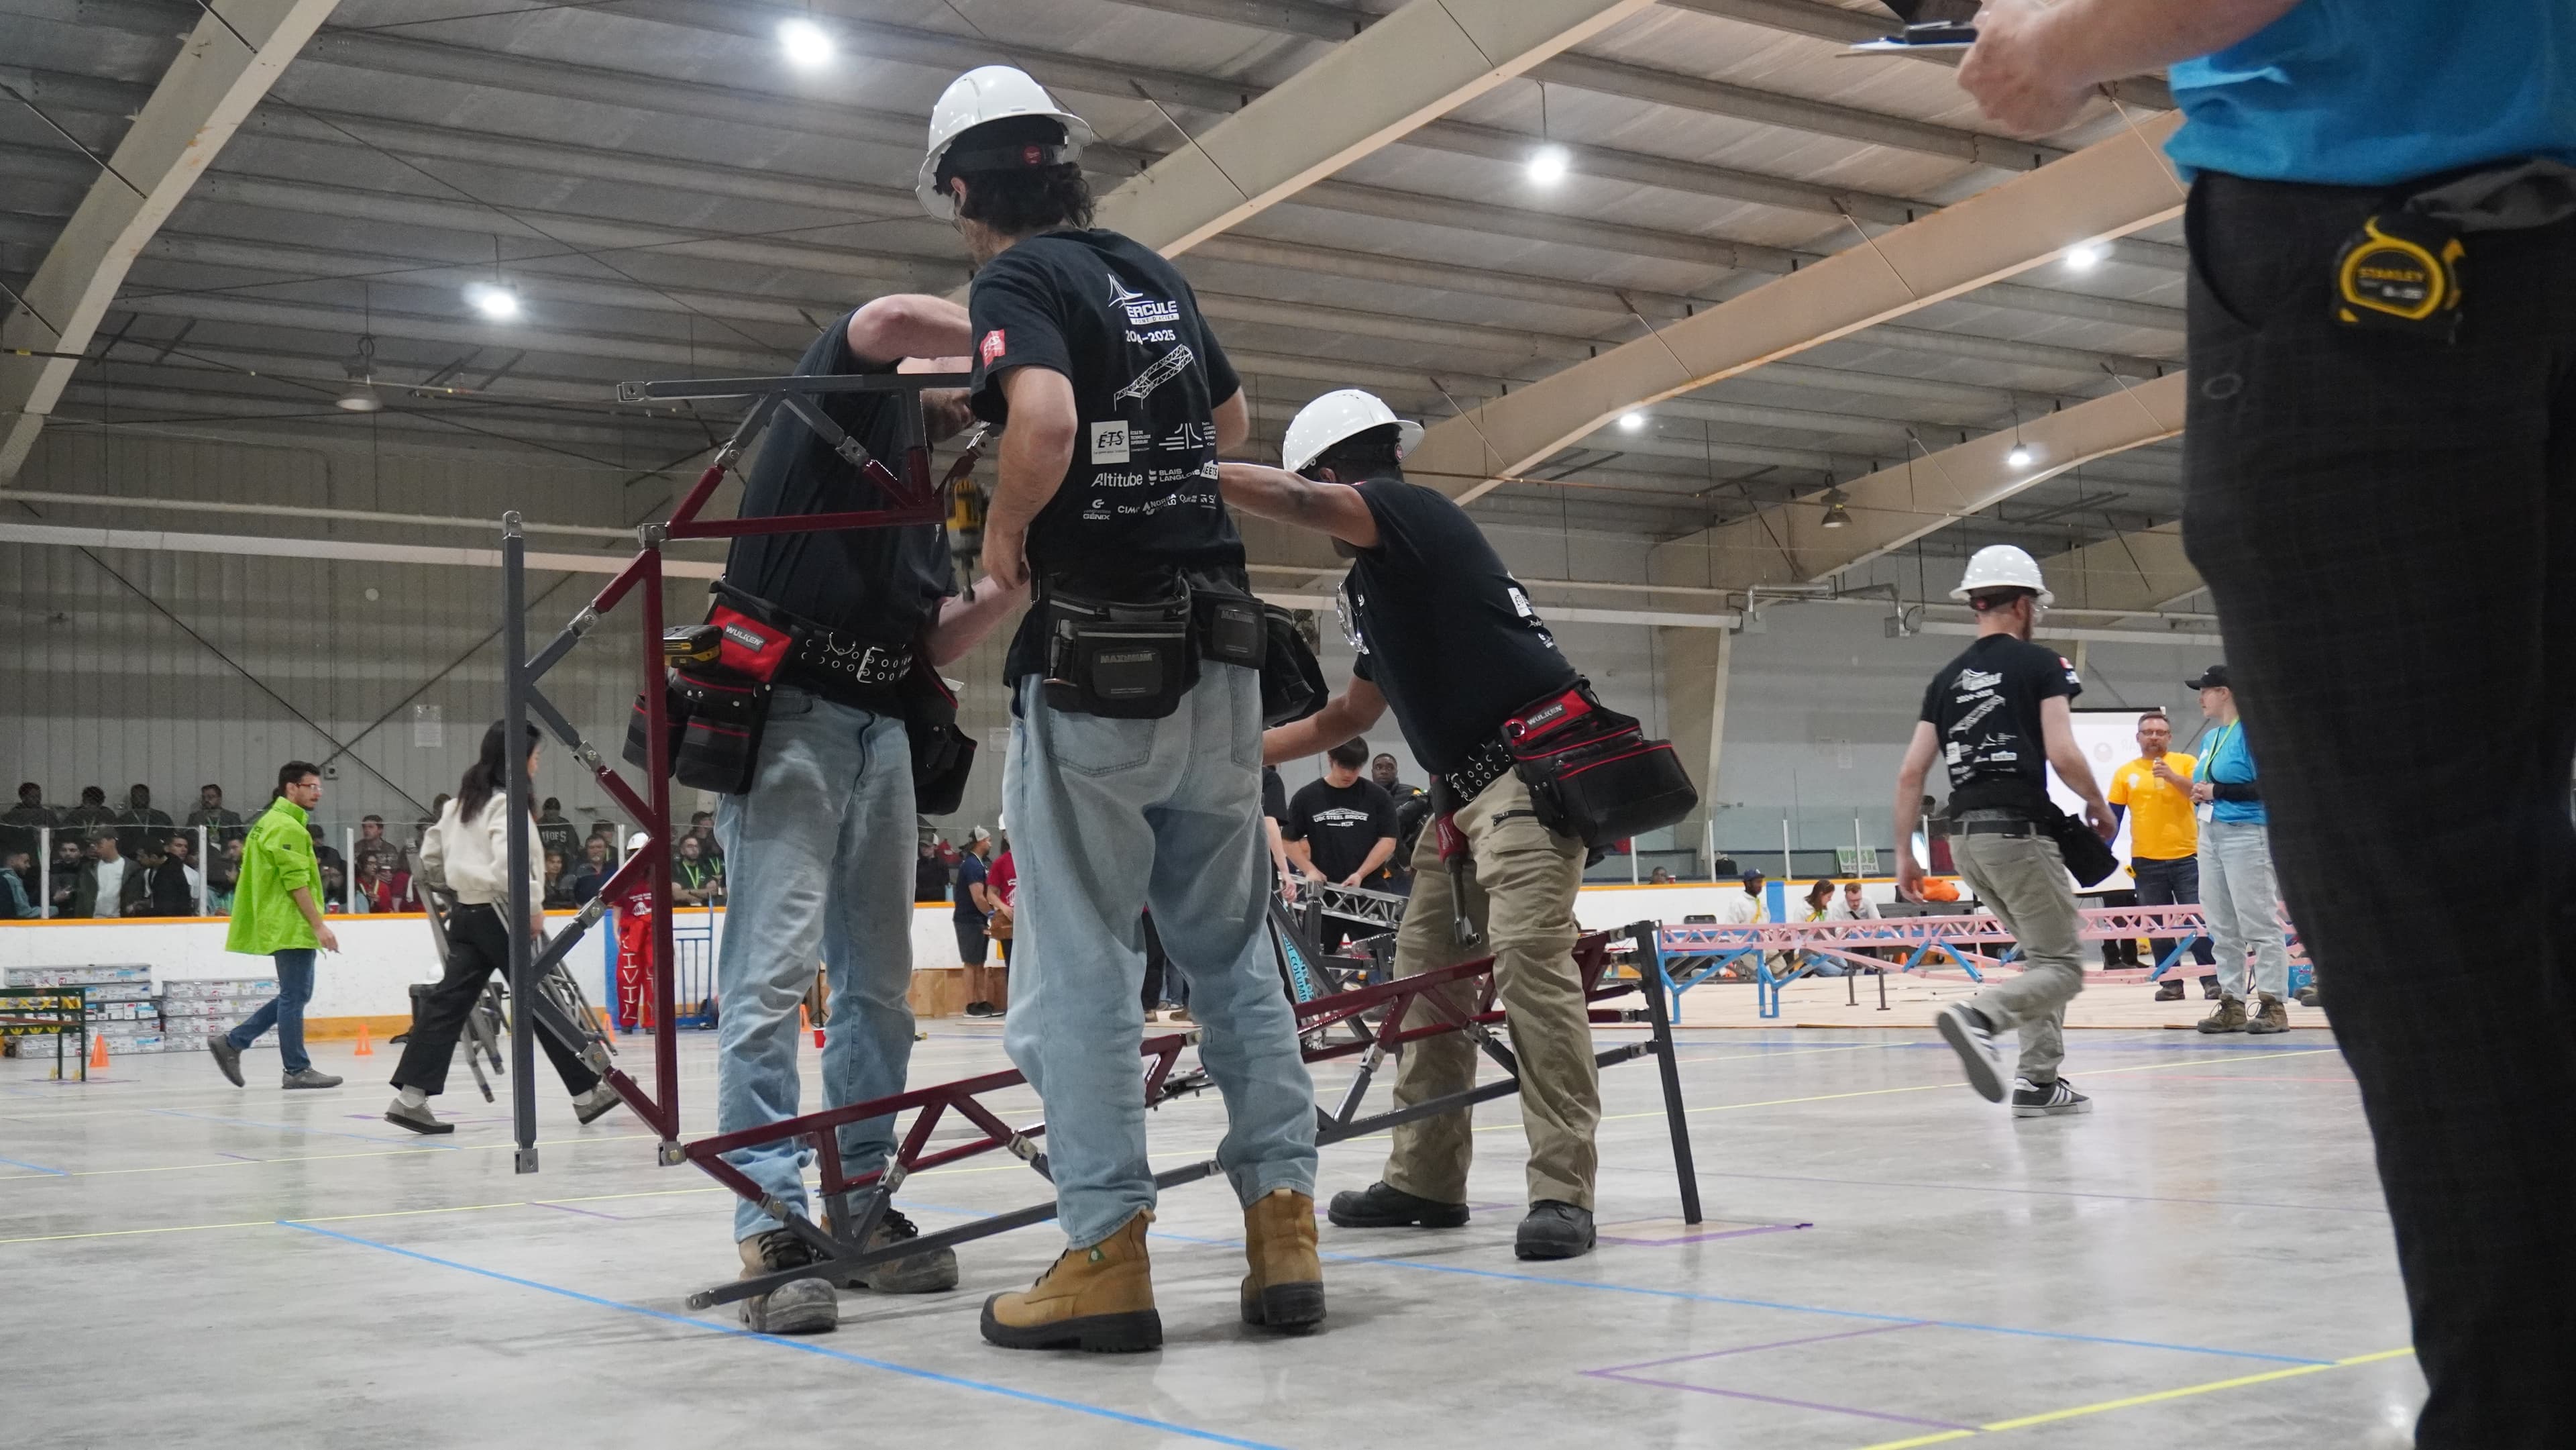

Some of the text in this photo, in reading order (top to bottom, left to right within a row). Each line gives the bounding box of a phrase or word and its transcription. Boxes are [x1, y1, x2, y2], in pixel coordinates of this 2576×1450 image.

[1098, 431, 1124, 448] ÉTS
[1091, 472, 1143, 487] Altitube
[1159, 469, 1201, 482] LANGLOIS
[726, 625, 763, 645] WULKEN
[1527, 704, 1562, 725] WULKEN
